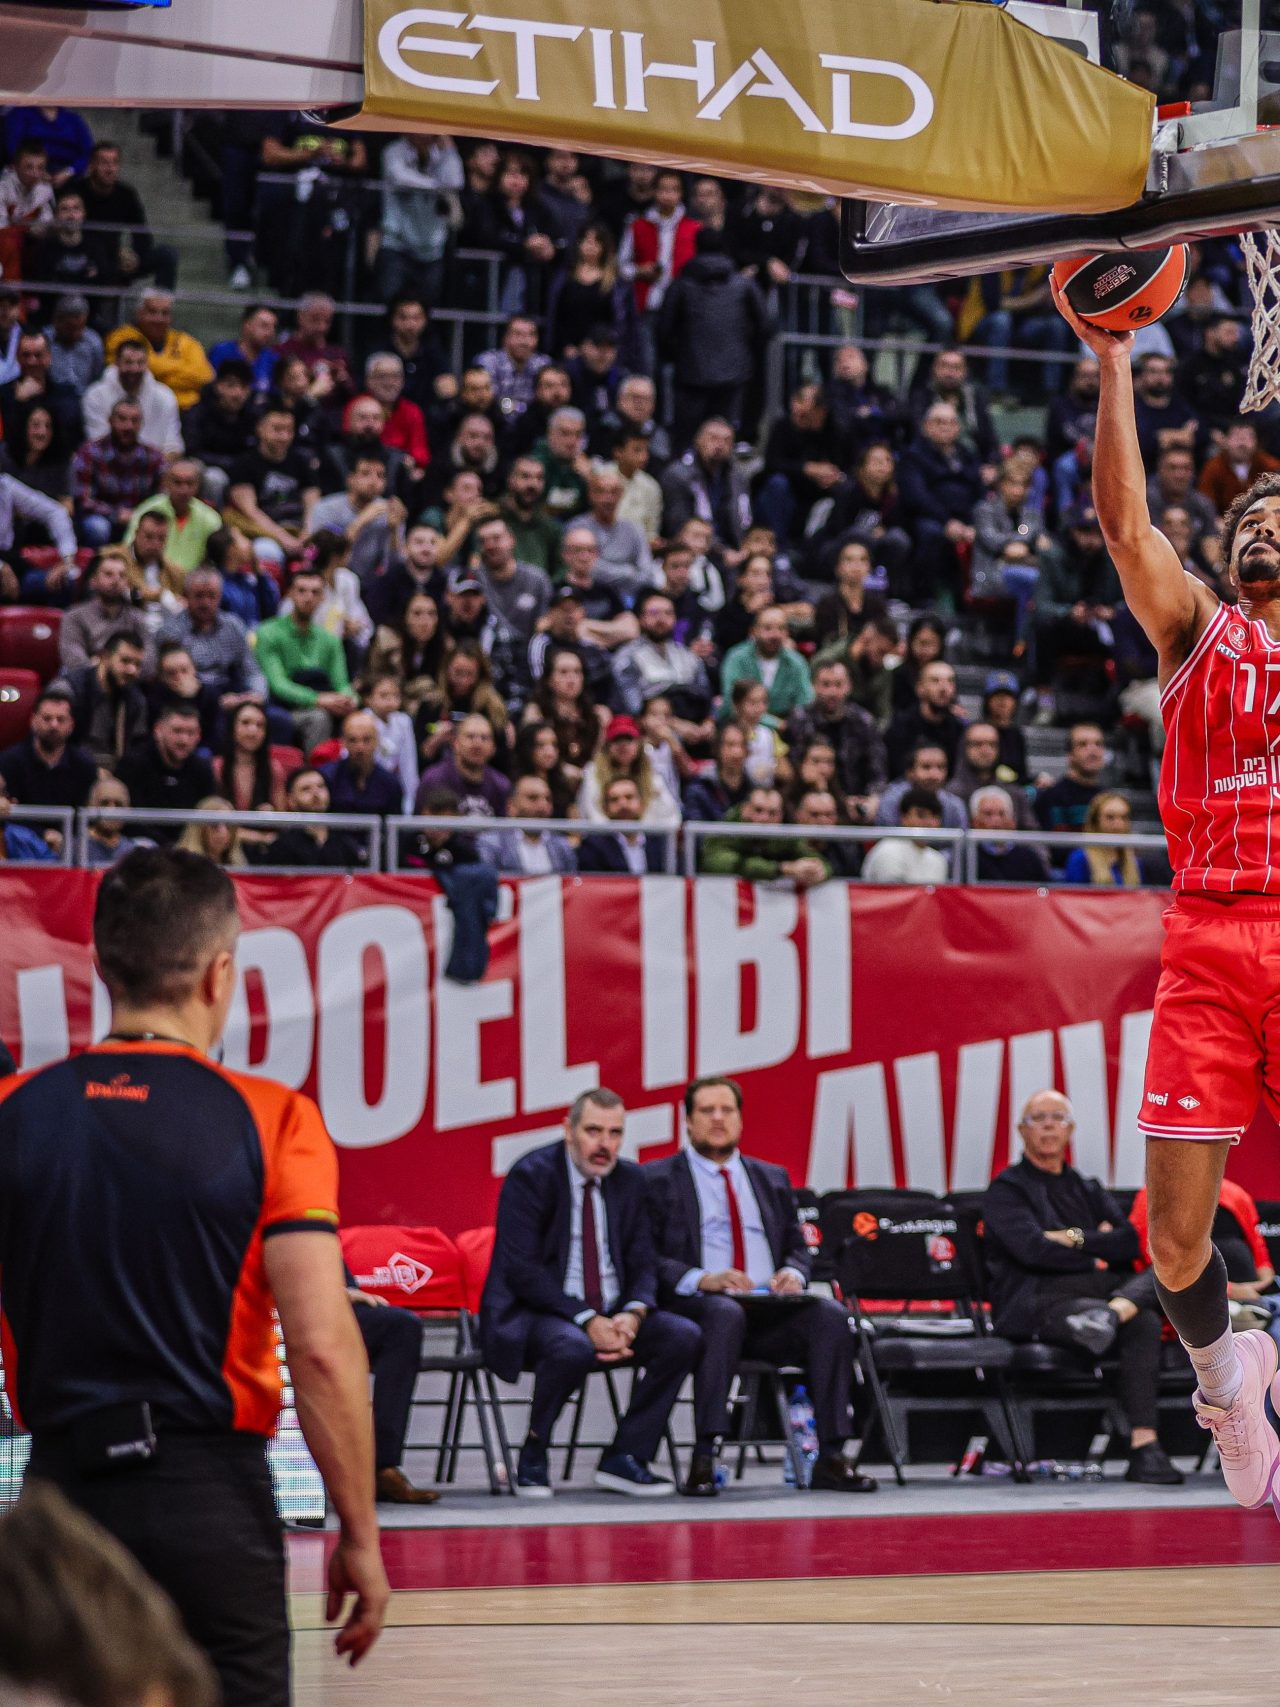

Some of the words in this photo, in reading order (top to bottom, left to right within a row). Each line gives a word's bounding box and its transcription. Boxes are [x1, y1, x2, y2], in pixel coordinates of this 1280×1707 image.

[377, 8, 935, 141] ETIHAD
[1243, 756, 1267, 772] בית
[640, 875, 852, 1091] IBI
